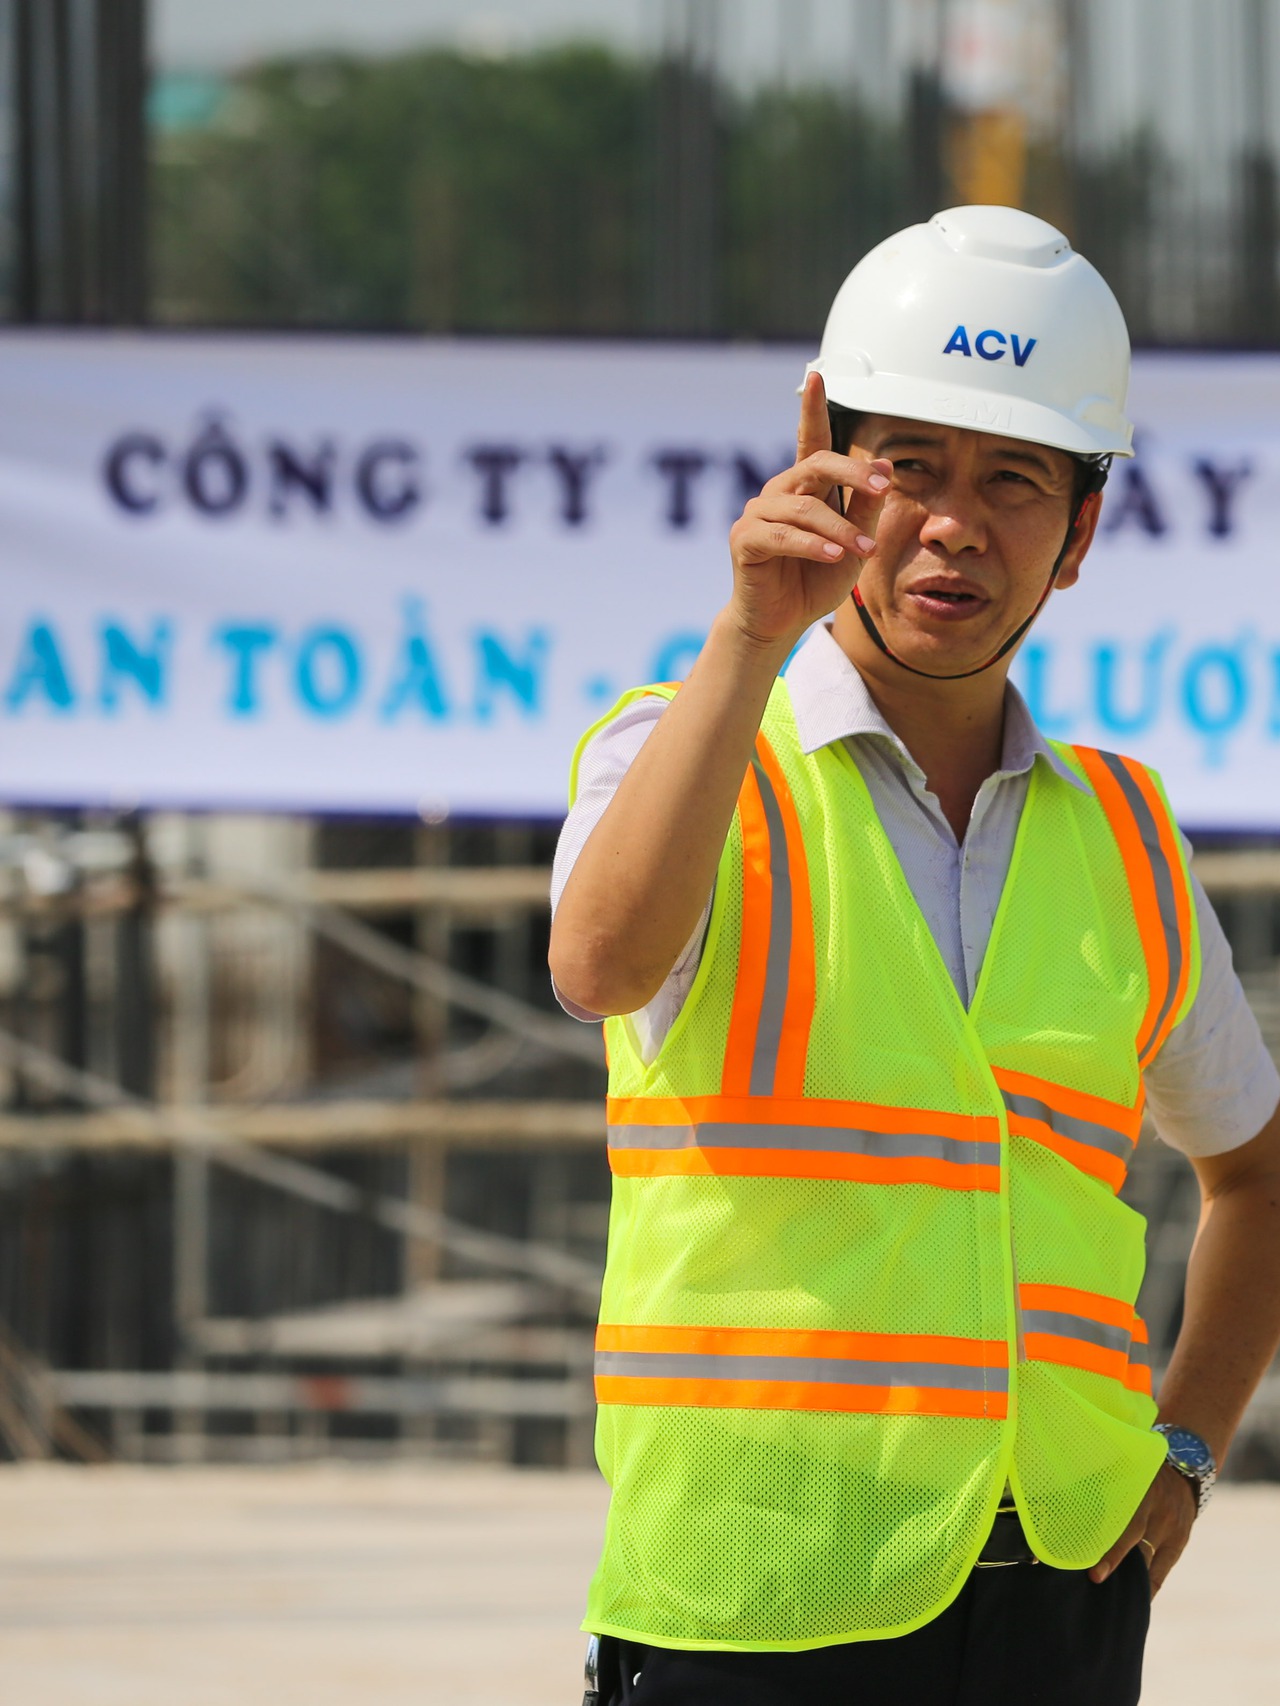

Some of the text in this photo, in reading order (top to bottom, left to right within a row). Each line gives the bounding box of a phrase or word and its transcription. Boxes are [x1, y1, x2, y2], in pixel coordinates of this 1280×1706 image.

[943, 325, 1038, 368] ACV
[104, 412, 421, 522] CÔNG
[467, 445, 607, 527] TY
[6, 618, 171, 714] AN
[216, 594, 548, 720] TOÀN
